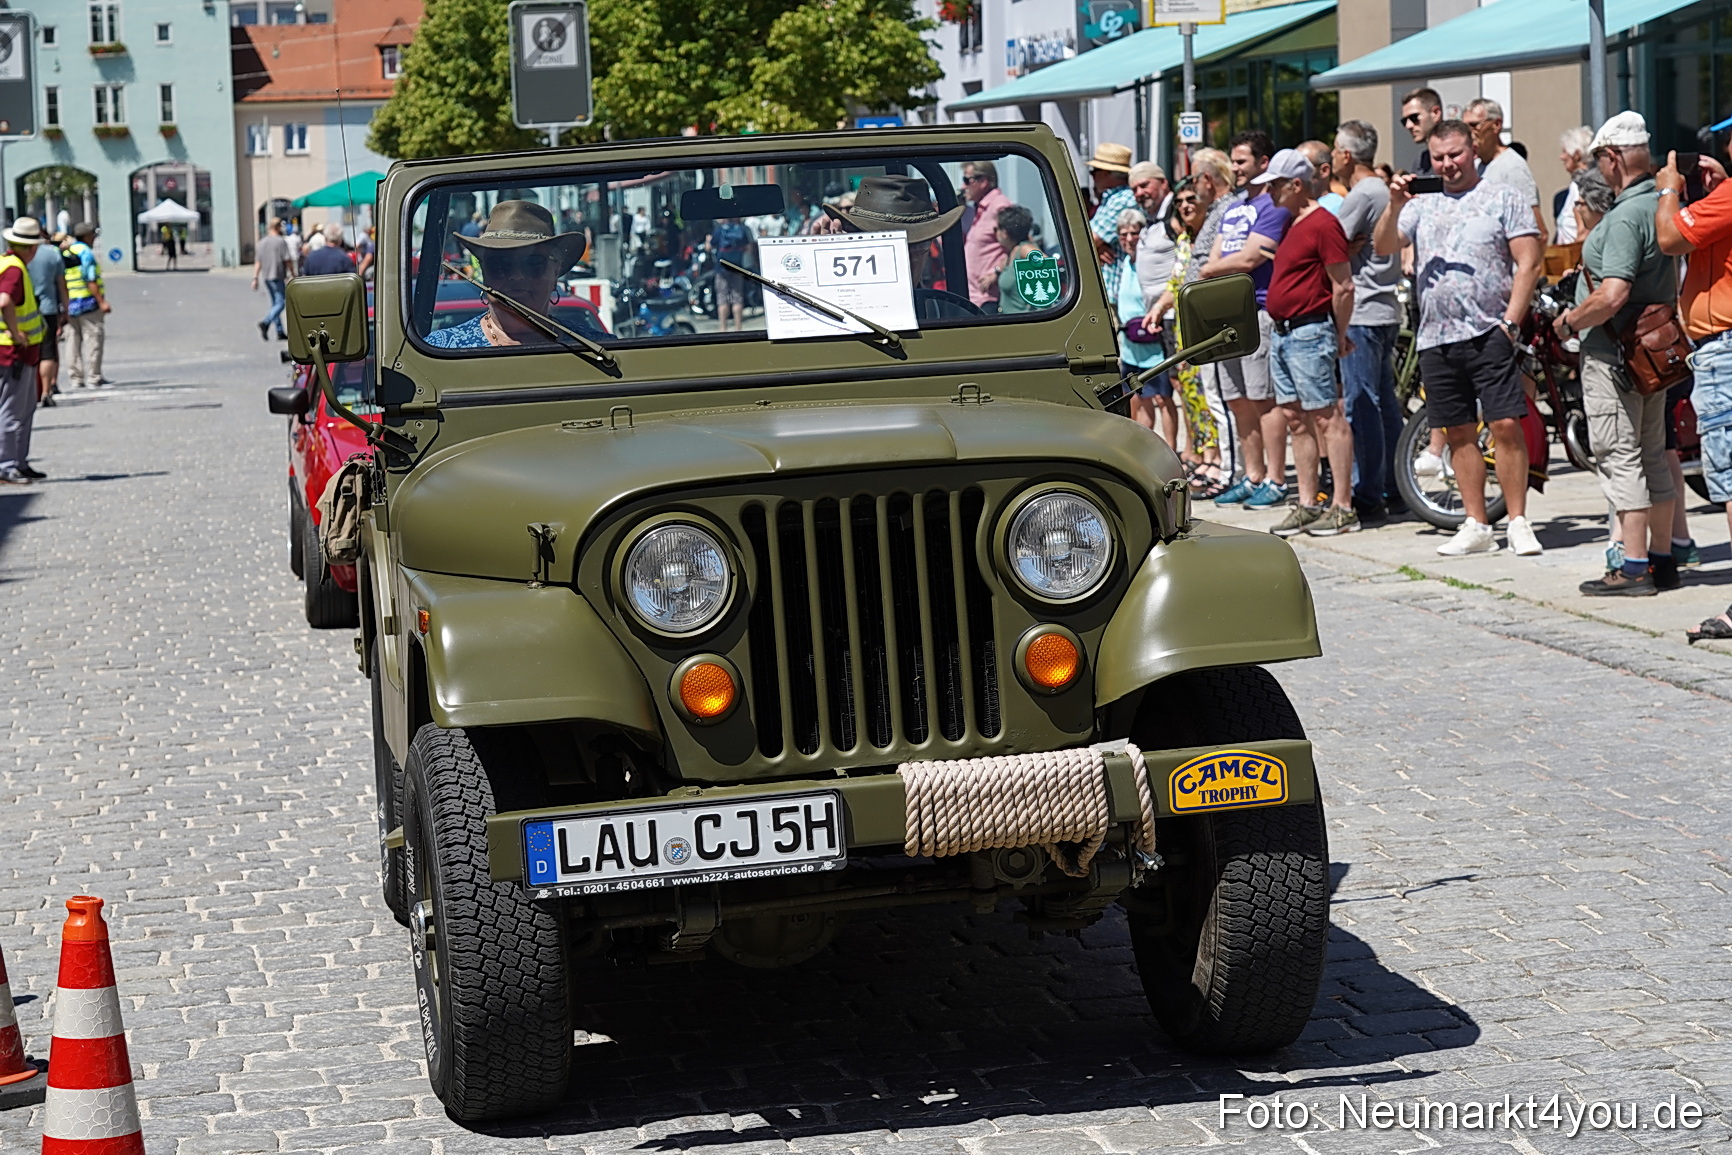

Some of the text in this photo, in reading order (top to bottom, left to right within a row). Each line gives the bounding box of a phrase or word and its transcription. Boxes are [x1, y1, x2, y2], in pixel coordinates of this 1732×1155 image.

[1100, 9, 1123, 38] G2
[832, 254, 877, 277] 571
[1018, 268, 1057, 280] FORST
[1178, 760, 1278, 794] CAMEL
[1198, 785, 1260, 804] TROPHY
[558, 819, 659, 875] LAU
[536, 860, 547, 874] D
[556, 888, 581, 897] Tel.:
[672, 864, 814, 886] www.b224-autoservice.de
